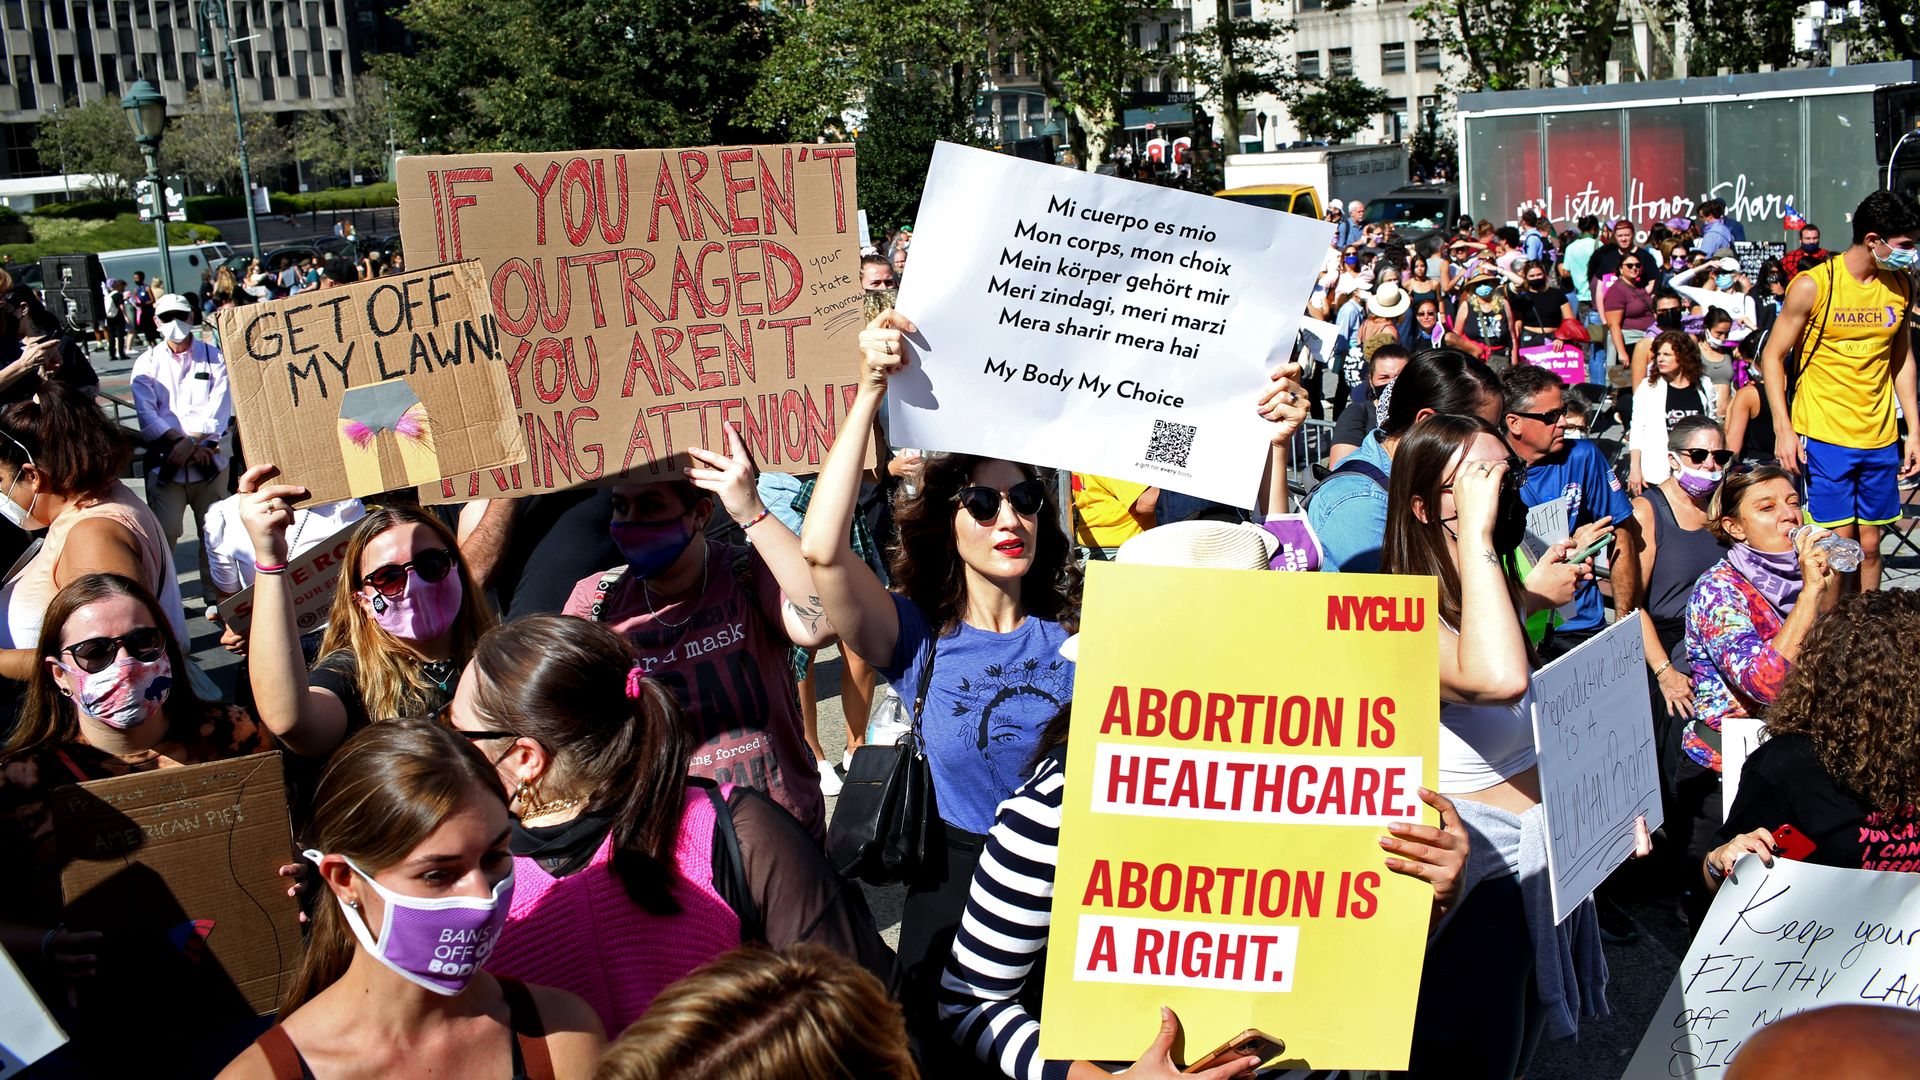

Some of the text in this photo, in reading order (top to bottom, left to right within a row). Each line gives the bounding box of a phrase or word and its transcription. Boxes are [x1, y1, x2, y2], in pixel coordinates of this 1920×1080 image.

[428, 147, 855, 262] IF YOU AREN'T
[1047, 194, 1217, 243] Mi cuerpo es mio
[1014, 219, 1232, 276] Mon corps, mon choix
[490, 240, 804, 337] OUTRAGED
[987, 275, 1227, 335] Meri zindagi, meri marzi
[1000, 247, 1230, 306] Mein körper gehört mir
[244, 270, 455, 362] GET OFF
[998, 306, 1201, 359] Mera sharir mera hai
[1833, 312, 1882, 323] MARCH
[288, 313, 503, 408] MY LAWN!
[504, 317, 812, 409] YOU AREN'T
[983, 357, 1184, 408] My Body My Choice
[441, 406, 604, 498] ING
[684, 623, 746, 660] mask
[1326, 594, 1425, 633] NYCLU
[1099, 685, 1396, 749] ABORTION IS
[716, 738, 761, 760] forced
[763, 734, 773, 744] to
[1106, 754, 1416, 817] HEALTHCARE.
[95, 813, 200, 851] AMERICAN
[1081, 859, 1381, 920] ABORTION IS
[1719, 874, 1834, 959] Keep
[434, 945, 475, 961] OFF
[438, 925, 492, 943] BANS
[1086, 925, 1283, 983] A RIGHT.
[1684, 954, 1837, 998] FILTHY
[1673, 1006, 1730, 1031] off
[1668, 1033, 1742, 1078] SIL
